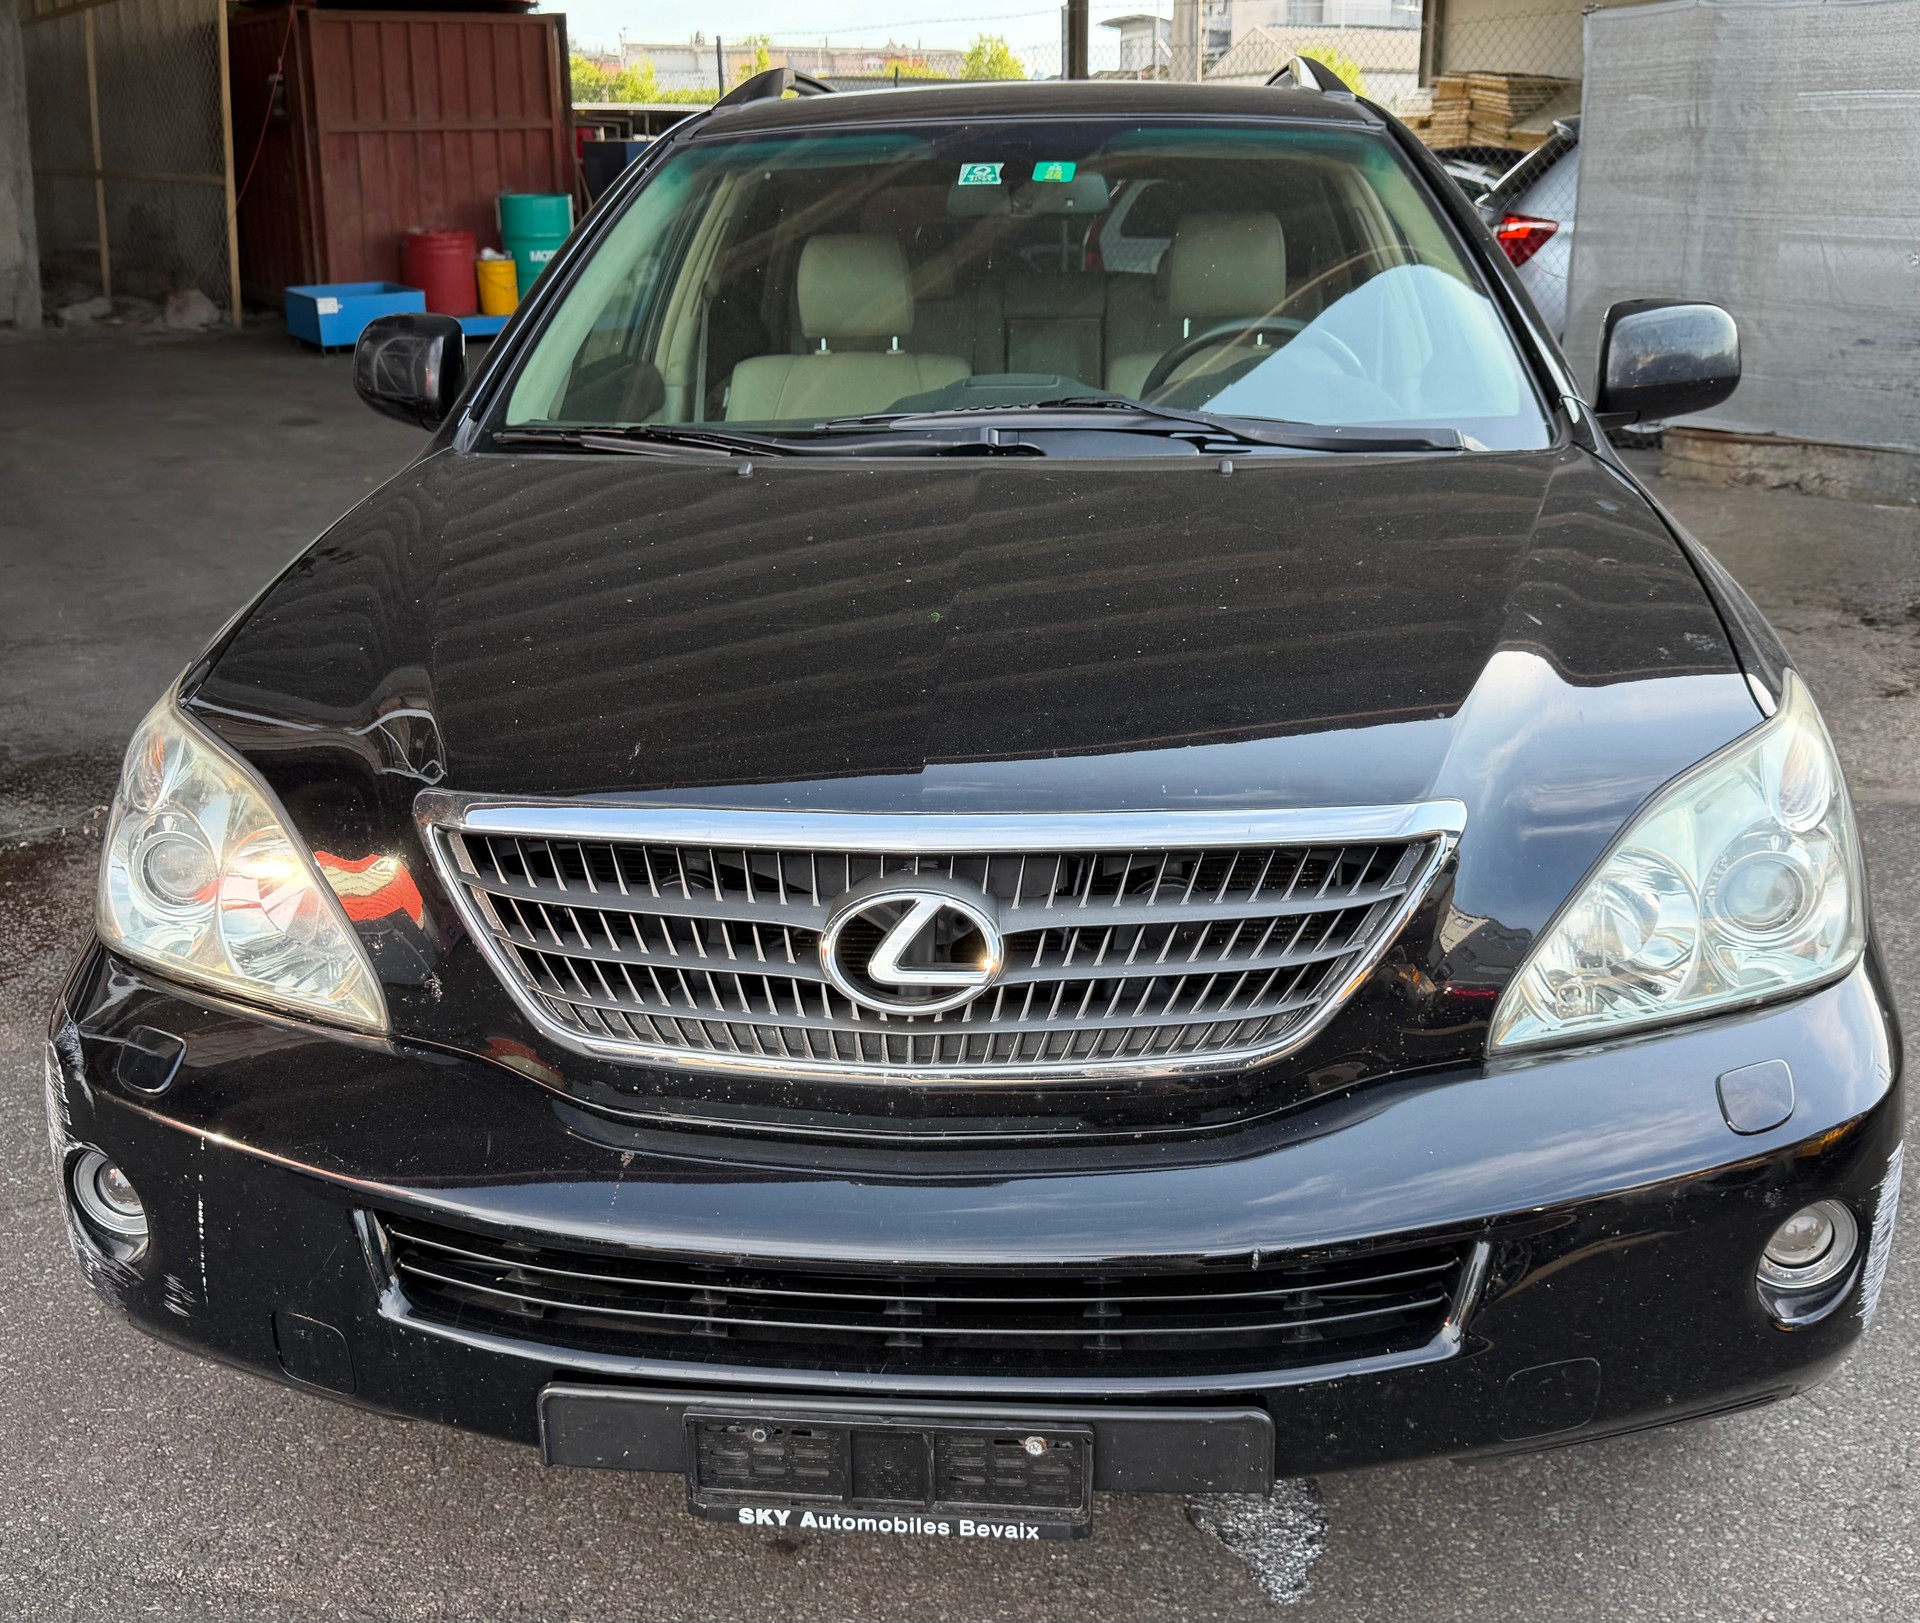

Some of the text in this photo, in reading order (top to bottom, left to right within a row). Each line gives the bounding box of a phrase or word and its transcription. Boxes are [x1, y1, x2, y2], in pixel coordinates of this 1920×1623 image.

[738, 1507, 1040, 1540] SKY Automobiles Bevaix
